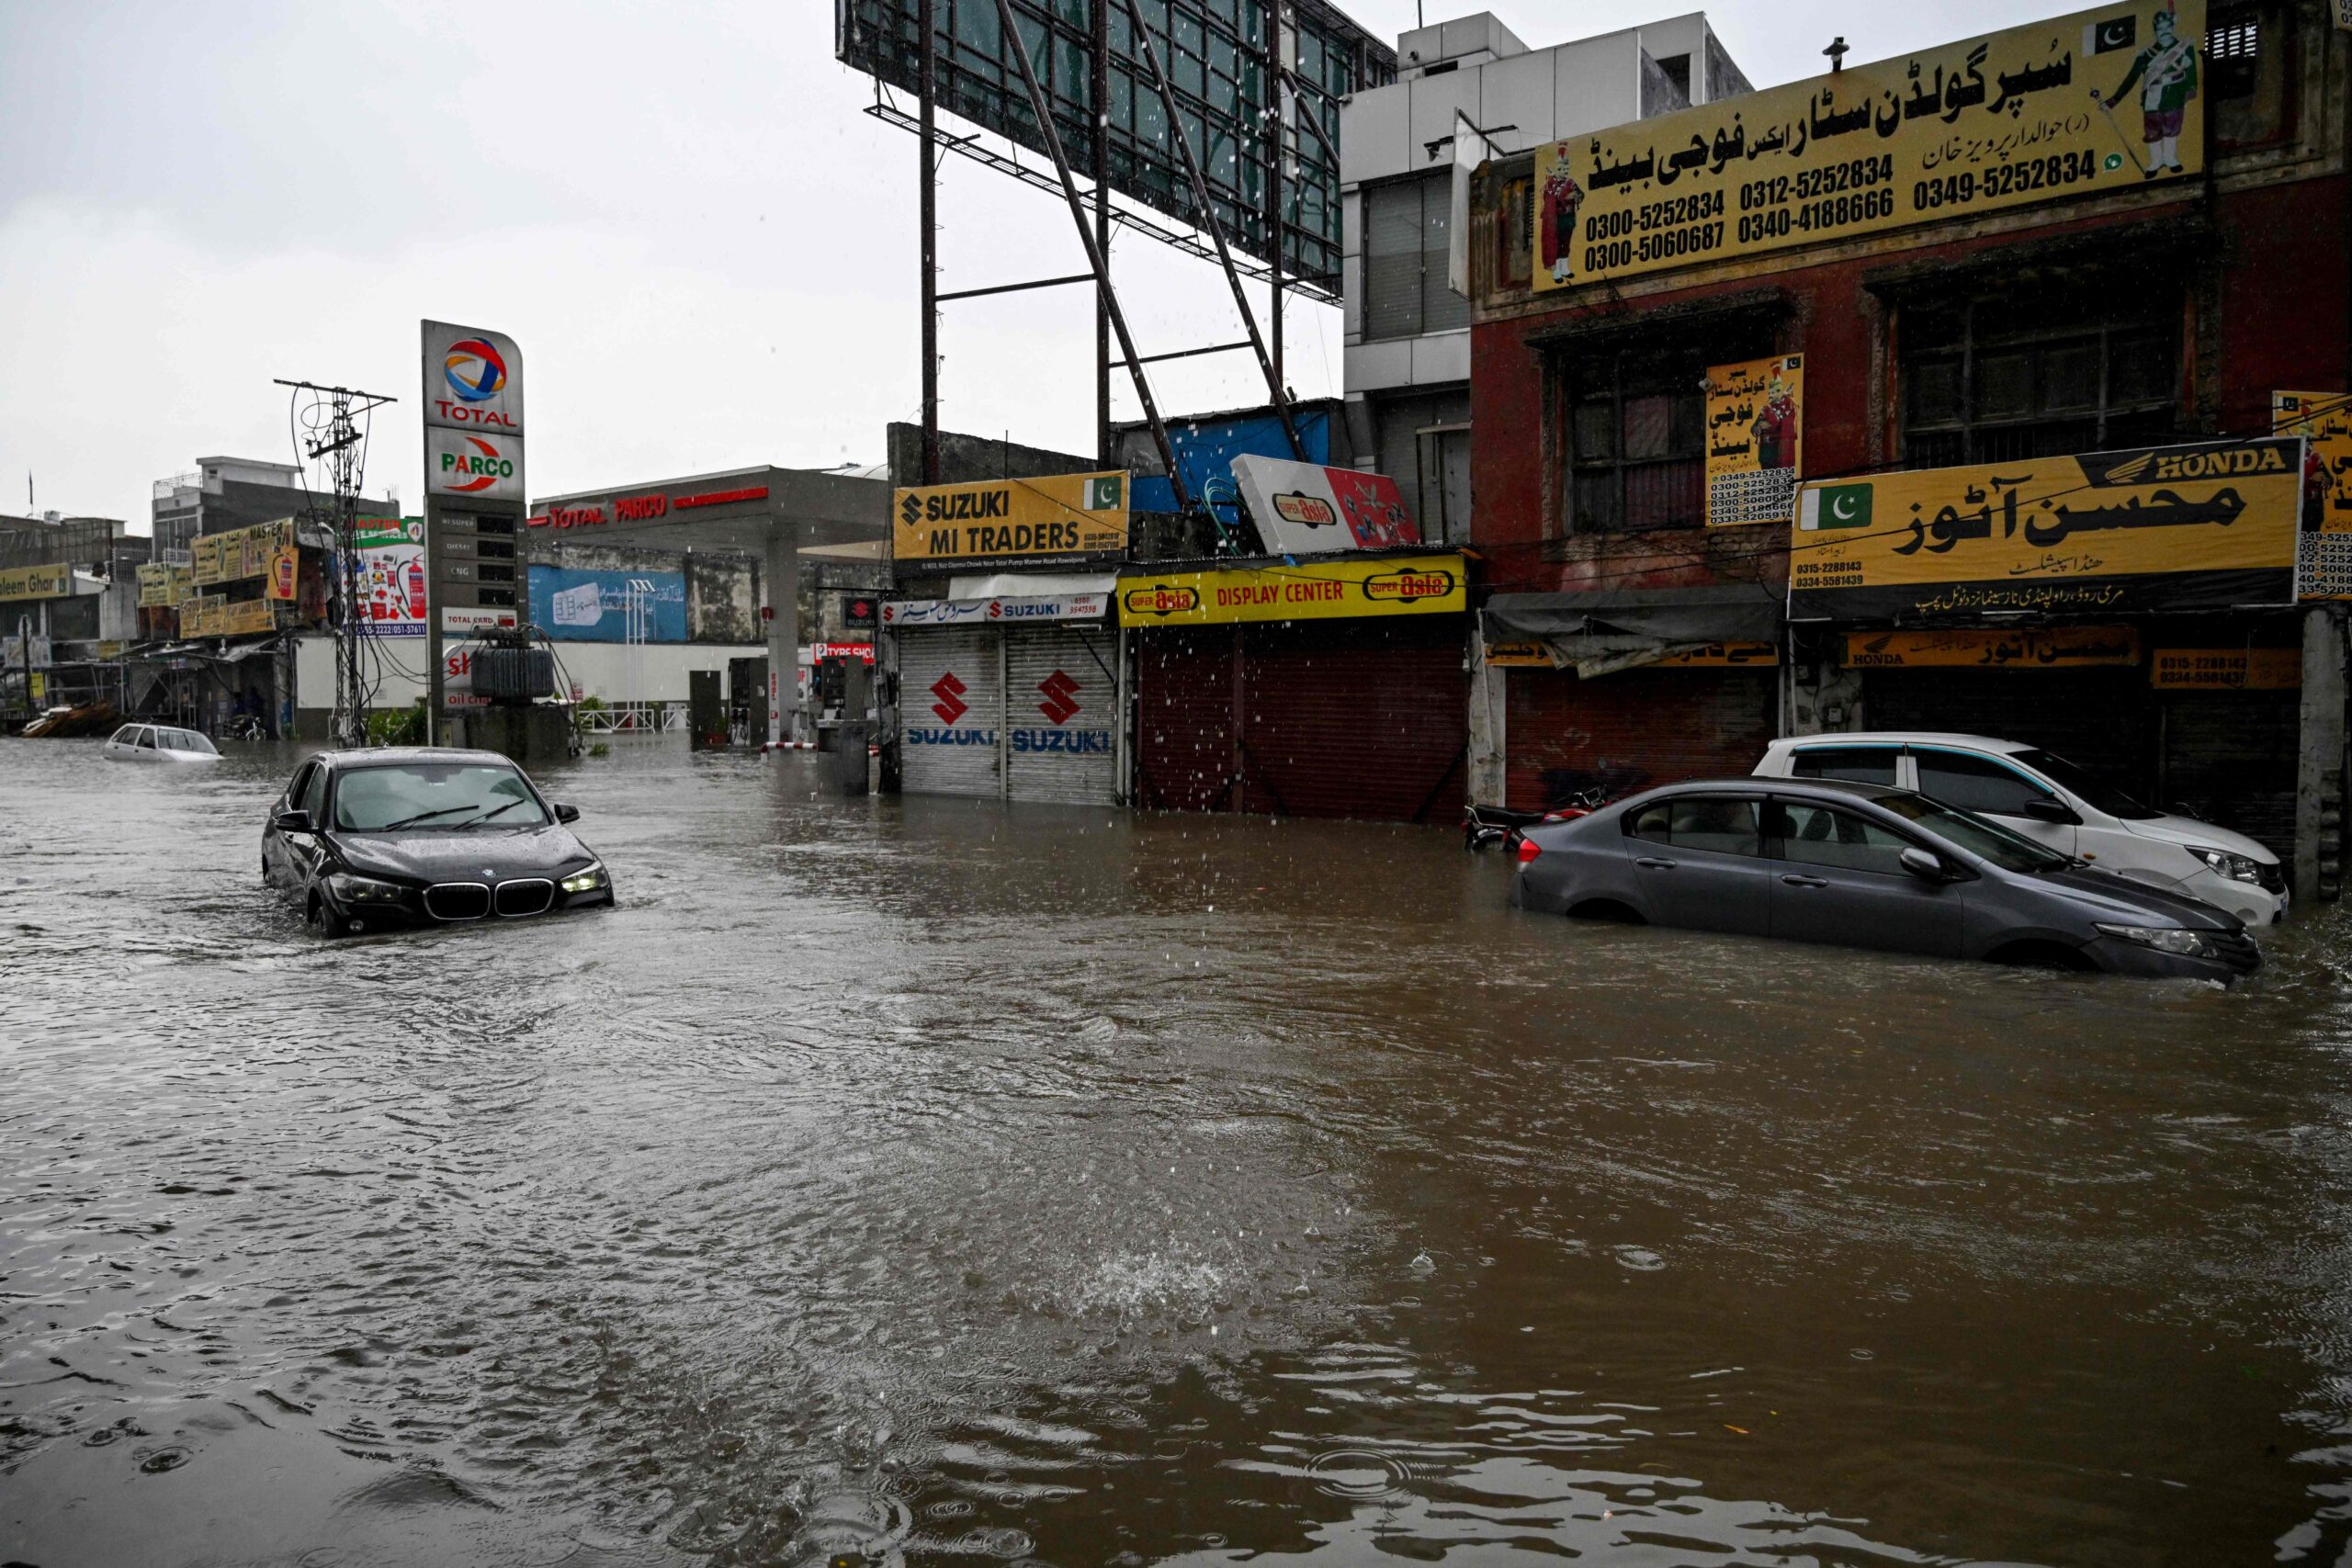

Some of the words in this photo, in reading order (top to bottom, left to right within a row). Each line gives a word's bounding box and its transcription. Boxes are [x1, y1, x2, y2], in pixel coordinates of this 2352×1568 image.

[1875, 42, 1989, 138] گولڈن
[1789, 87, 1871, 157] سٹار
[1657, 113, 1745, 186] فوجی
[1922, 136, 1962, 170] خان
[1589, 138, 1654, 195] بینڈ
[1740, 153, 1894, 211] 0312-5252834
[1914, 149, 2096, 210] 0349-5252834
[1586, 189, 1725, 243] 0300-5252834
[1738, 187, 1894, 243] 0340-4188666
[1585, 220, 1725, 273] 0300-5060687
[435, 400, 517, 427] TOTAL
[1710, 397, 1753, 430] فوجی
[1711, 431, 1750, 461] بینڈ
[441, 453, 514, 478] PARCO
[1720, 468, 1795, 481] 0349-5252834
[2155, 446, 2287, 479] HONDA
[1711, 478, 1794, 491] 0300-5252834
[549, 507, 608, 529] TOTAL
[615, 493, 667, 523] PARCO
[926, 491, 1010, 521] SUZUKI
[1298, 499, 1331, 523] asia
[1711, 494, 1793, 507] 0300-5060687
[1711, 502, 1793, 515] 0340-4188666
[351, 518, 401, 530] ASTER
[1711, 511, 1793, 524] 0333-5205910
[1891, 474, 2032, 556] آٹوز
[2025, 487, 2247, 548] محسن
[250, 522, 283, 540] MASTER
[930, 528, 958, 554] MI
[967, 521, 1079, 552] TRADERS
[451, 567, 469, 575] CNG
[1797, 561, 1861, 574] 0315-2288143
[29, 573, 54, 592] Ghar
[1217, 585, 1279, 606] DISPLAY
[1286, 580, 1344, 603] CENTER
[1370, 581, 1398, 593] SUPER
[1400, 574, 1442, 596] asia
[1796, 575, 1863, 587] 0334-5581439
[1004, 604, 1060, 617] SUZUKI
[1131, 596, 1154, 607] SUPER
[1155, 591, 1191, 609] asia
[447, 615, 471, 624] TOTAL
[473, 616, 493, 625] CARD
[1853, 654, 1905, 665] HONDA
[2161, 657, 2247, 670] 0315-2288143
[448, 691, 464, 705] oil
[908, 728, 993, 745] SUZUKI
[1012, 729, 1110, 752] SUZUKI
